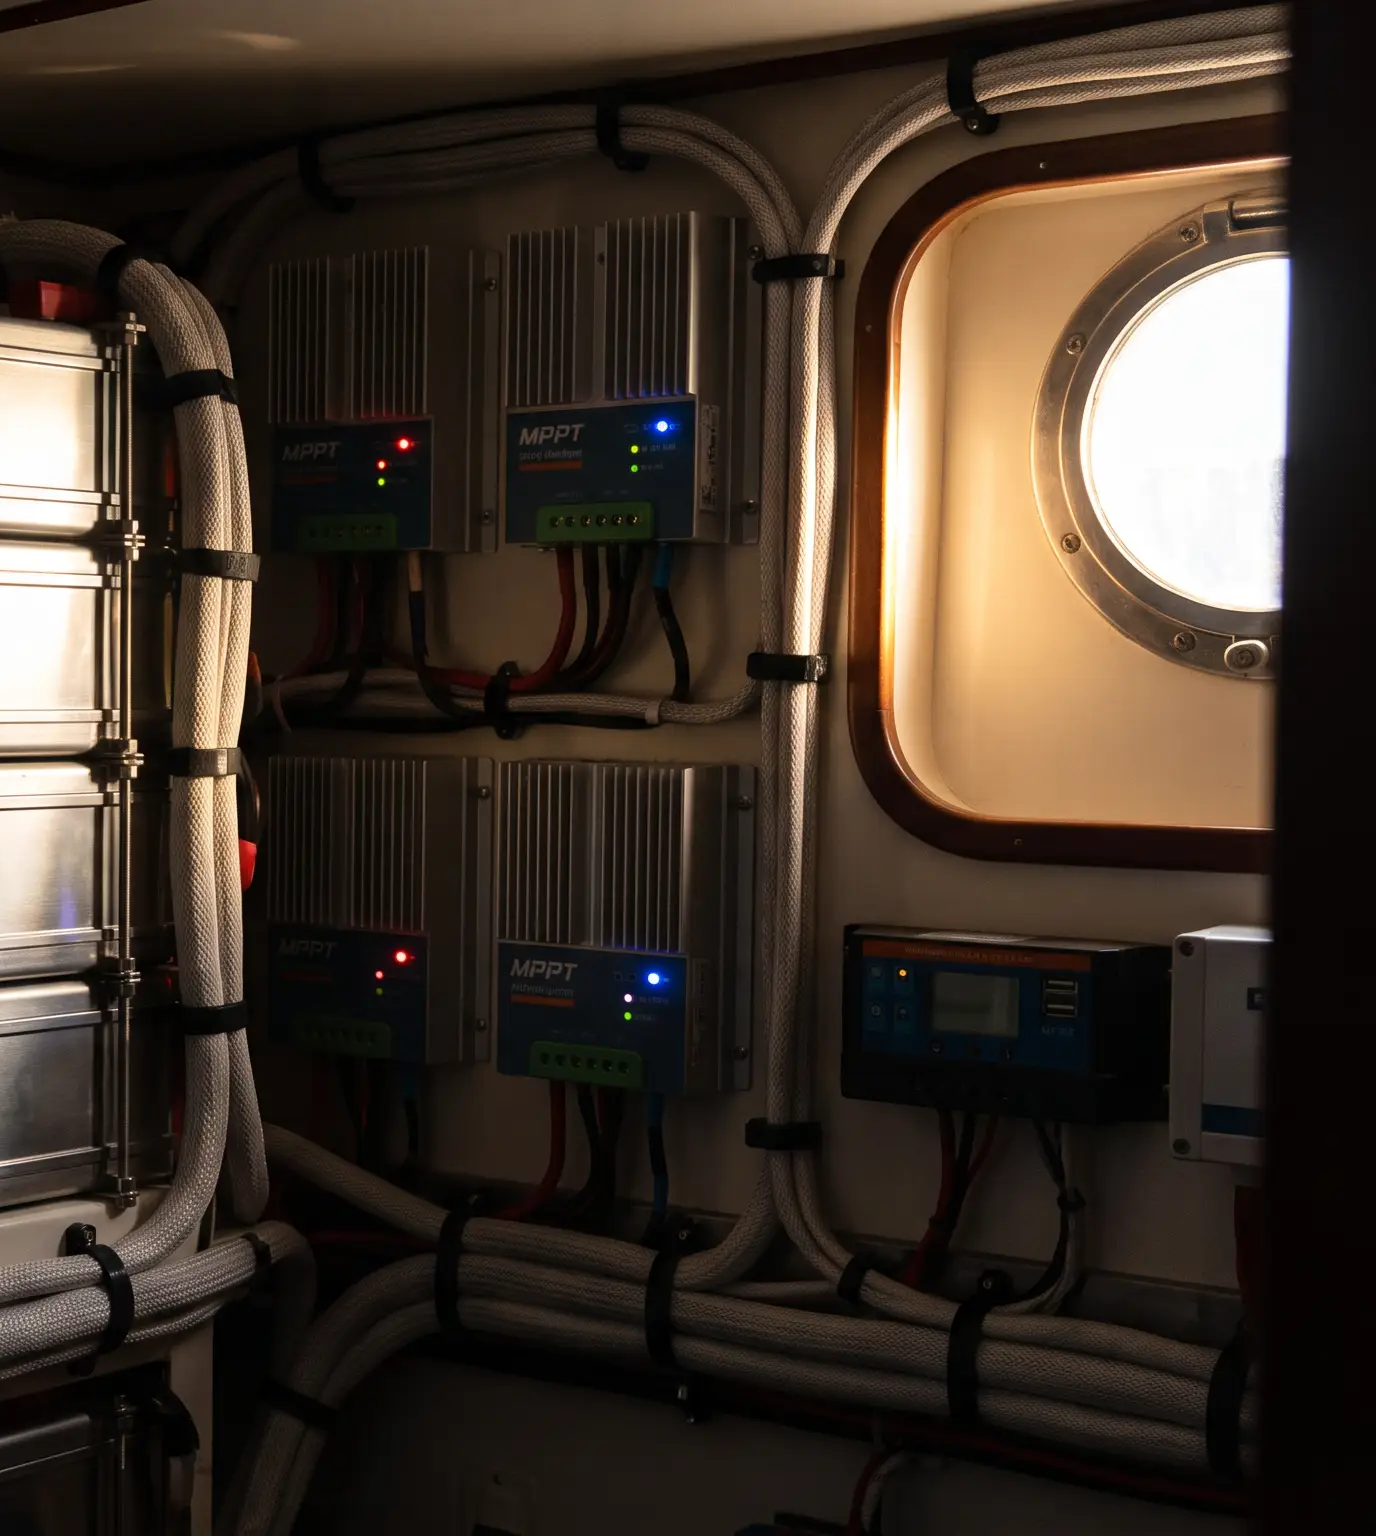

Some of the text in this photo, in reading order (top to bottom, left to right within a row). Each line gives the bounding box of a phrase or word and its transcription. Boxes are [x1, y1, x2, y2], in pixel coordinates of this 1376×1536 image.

[518, 423, 585, 446] MPPT
[281, 441, 342, 462] MPPT
[277, 937, 338, 960] MPPT
[510, 957, 579, 982] MPPT
